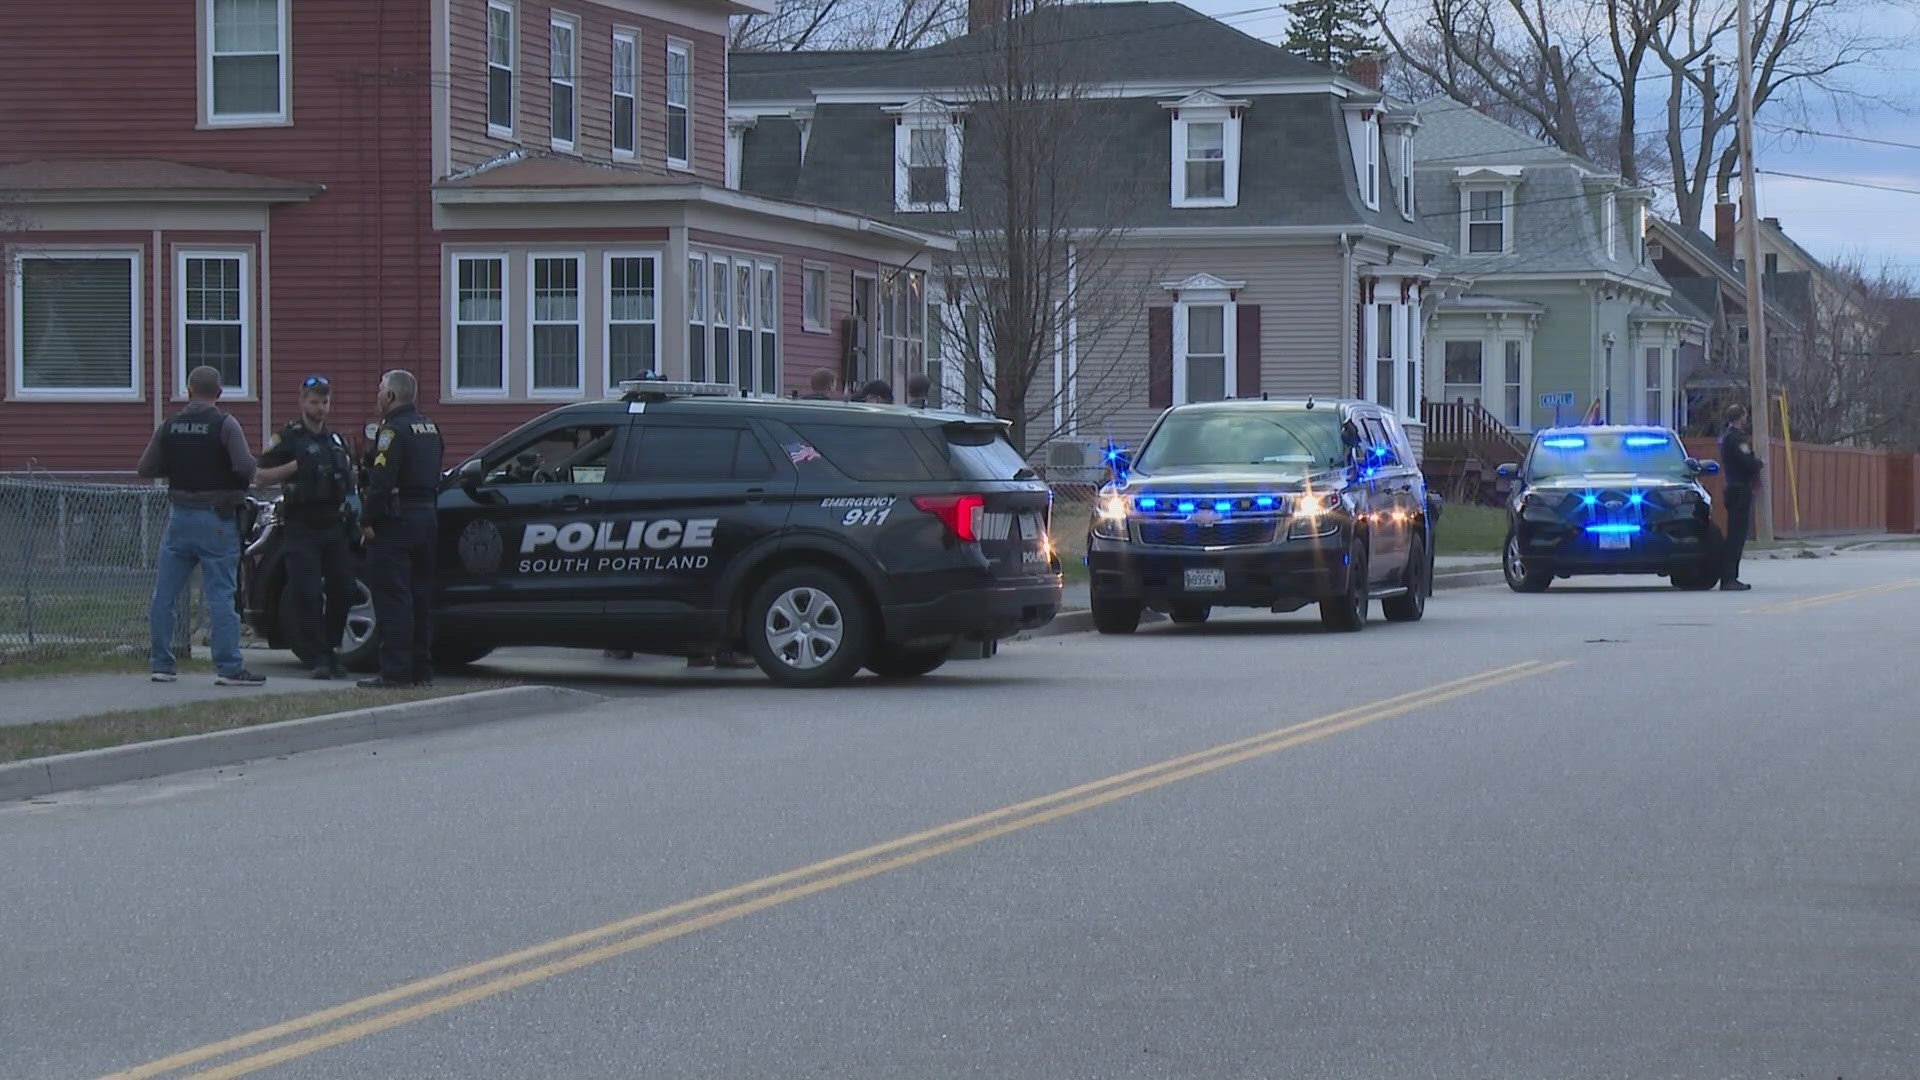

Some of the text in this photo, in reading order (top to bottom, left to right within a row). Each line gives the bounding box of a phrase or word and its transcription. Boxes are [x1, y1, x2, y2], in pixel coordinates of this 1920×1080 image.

[170, 423, 209, 434] POLICE
[411, 423, 438, 433] POLICE
[821, 497, 897, 507] EMERGENCY
[520, 518, 719, 553] POLICE
[519, 555, 709, 573] SOUTH PORTLAND
